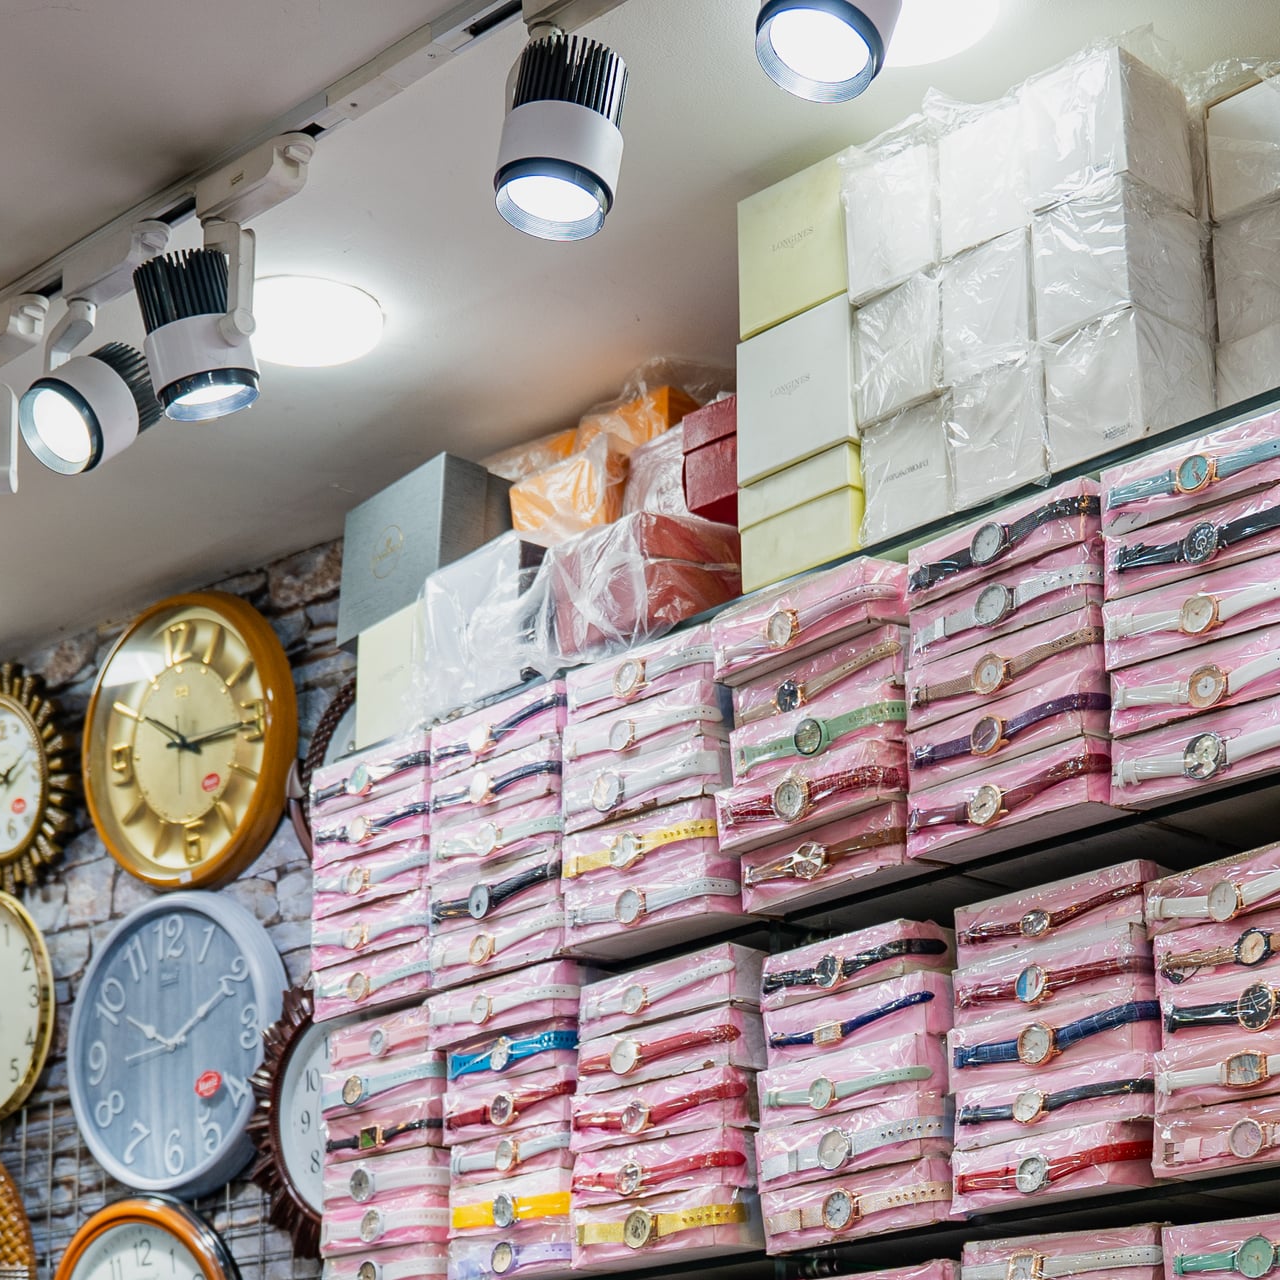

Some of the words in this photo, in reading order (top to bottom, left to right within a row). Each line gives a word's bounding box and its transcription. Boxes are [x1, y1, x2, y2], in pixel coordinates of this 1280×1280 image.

[123, 934, 149, 983] 11
[153, 914, 184, 960] 12
[198, 924, 216, 963] 1
[218, 956, 249, 996] 2
[96, 978, 126, 1026] 10
[239, 1003, 258, 1049] 3
[89, 1041, 108, 1086] 9
[95, 1090, 124, 1128] 8
[223, 1071, 250, 1108] 4
[124, 1120, 151, 1164] 7
[164, 1129, 184, 1176] 6
[197, 1106, 221, 1155] 5
[134, 1238, 152, 1267] 12
[170, 1248, 176, 1274] 1
